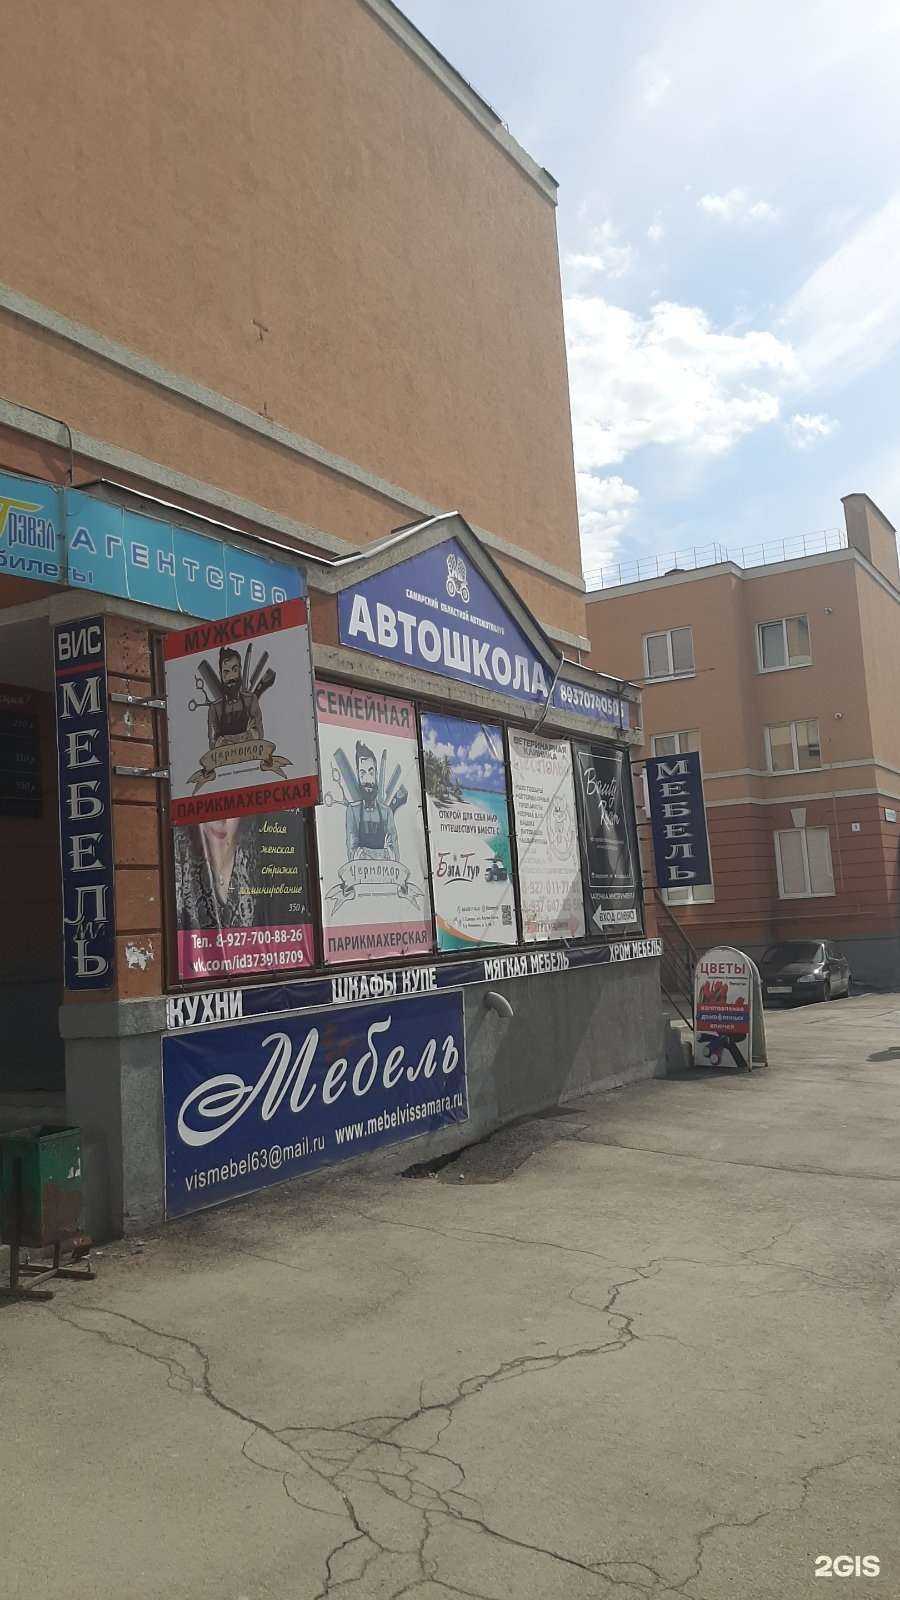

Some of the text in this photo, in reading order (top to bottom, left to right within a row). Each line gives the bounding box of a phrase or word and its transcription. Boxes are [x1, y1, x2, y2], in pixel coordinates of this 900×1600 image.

[71, 526, 287, 604] АГЕНТСТВО
[57, 625, 101, 661] ВИС
[184, 607, 283, 651] МУЖСКАЯ
[348, 594, 548, 697] АВТОШКОЛА
[316, 688, 410, 729] СЕМЕЙНАЯ
[177, 782, 311, 818] ПАРИКМАХЕРСКАЯ
[656, 759, 698, 881] МЕБЕЛЬ
[59, 676, 109, 978] МЕБЕЛЬ
[259, 821, 287, 833] Любая
[262, 864, 298, 877] стрижка
[191, 928, 303, 949] Тел. 8-927-700-88-26
[328, 928, 428, 953] ПАРИКМАХЕРСКАЯ
[193, 950, 304, 973] vk.com/id373918709
[701, 962, 746, 976] ЦВЕТЫ
[168, 938, 664, 1028] КУХНИ ШКАФЫ КУПЕ МЯГКАЯ МЕБЕЛЬ ХРОМ МЕБЕЛЬ
[177, 1015, 459, 1147] Мебель
[185, 1091, 463, 1192] vismebel63@mail.ru www.mebelvissamara.ru
